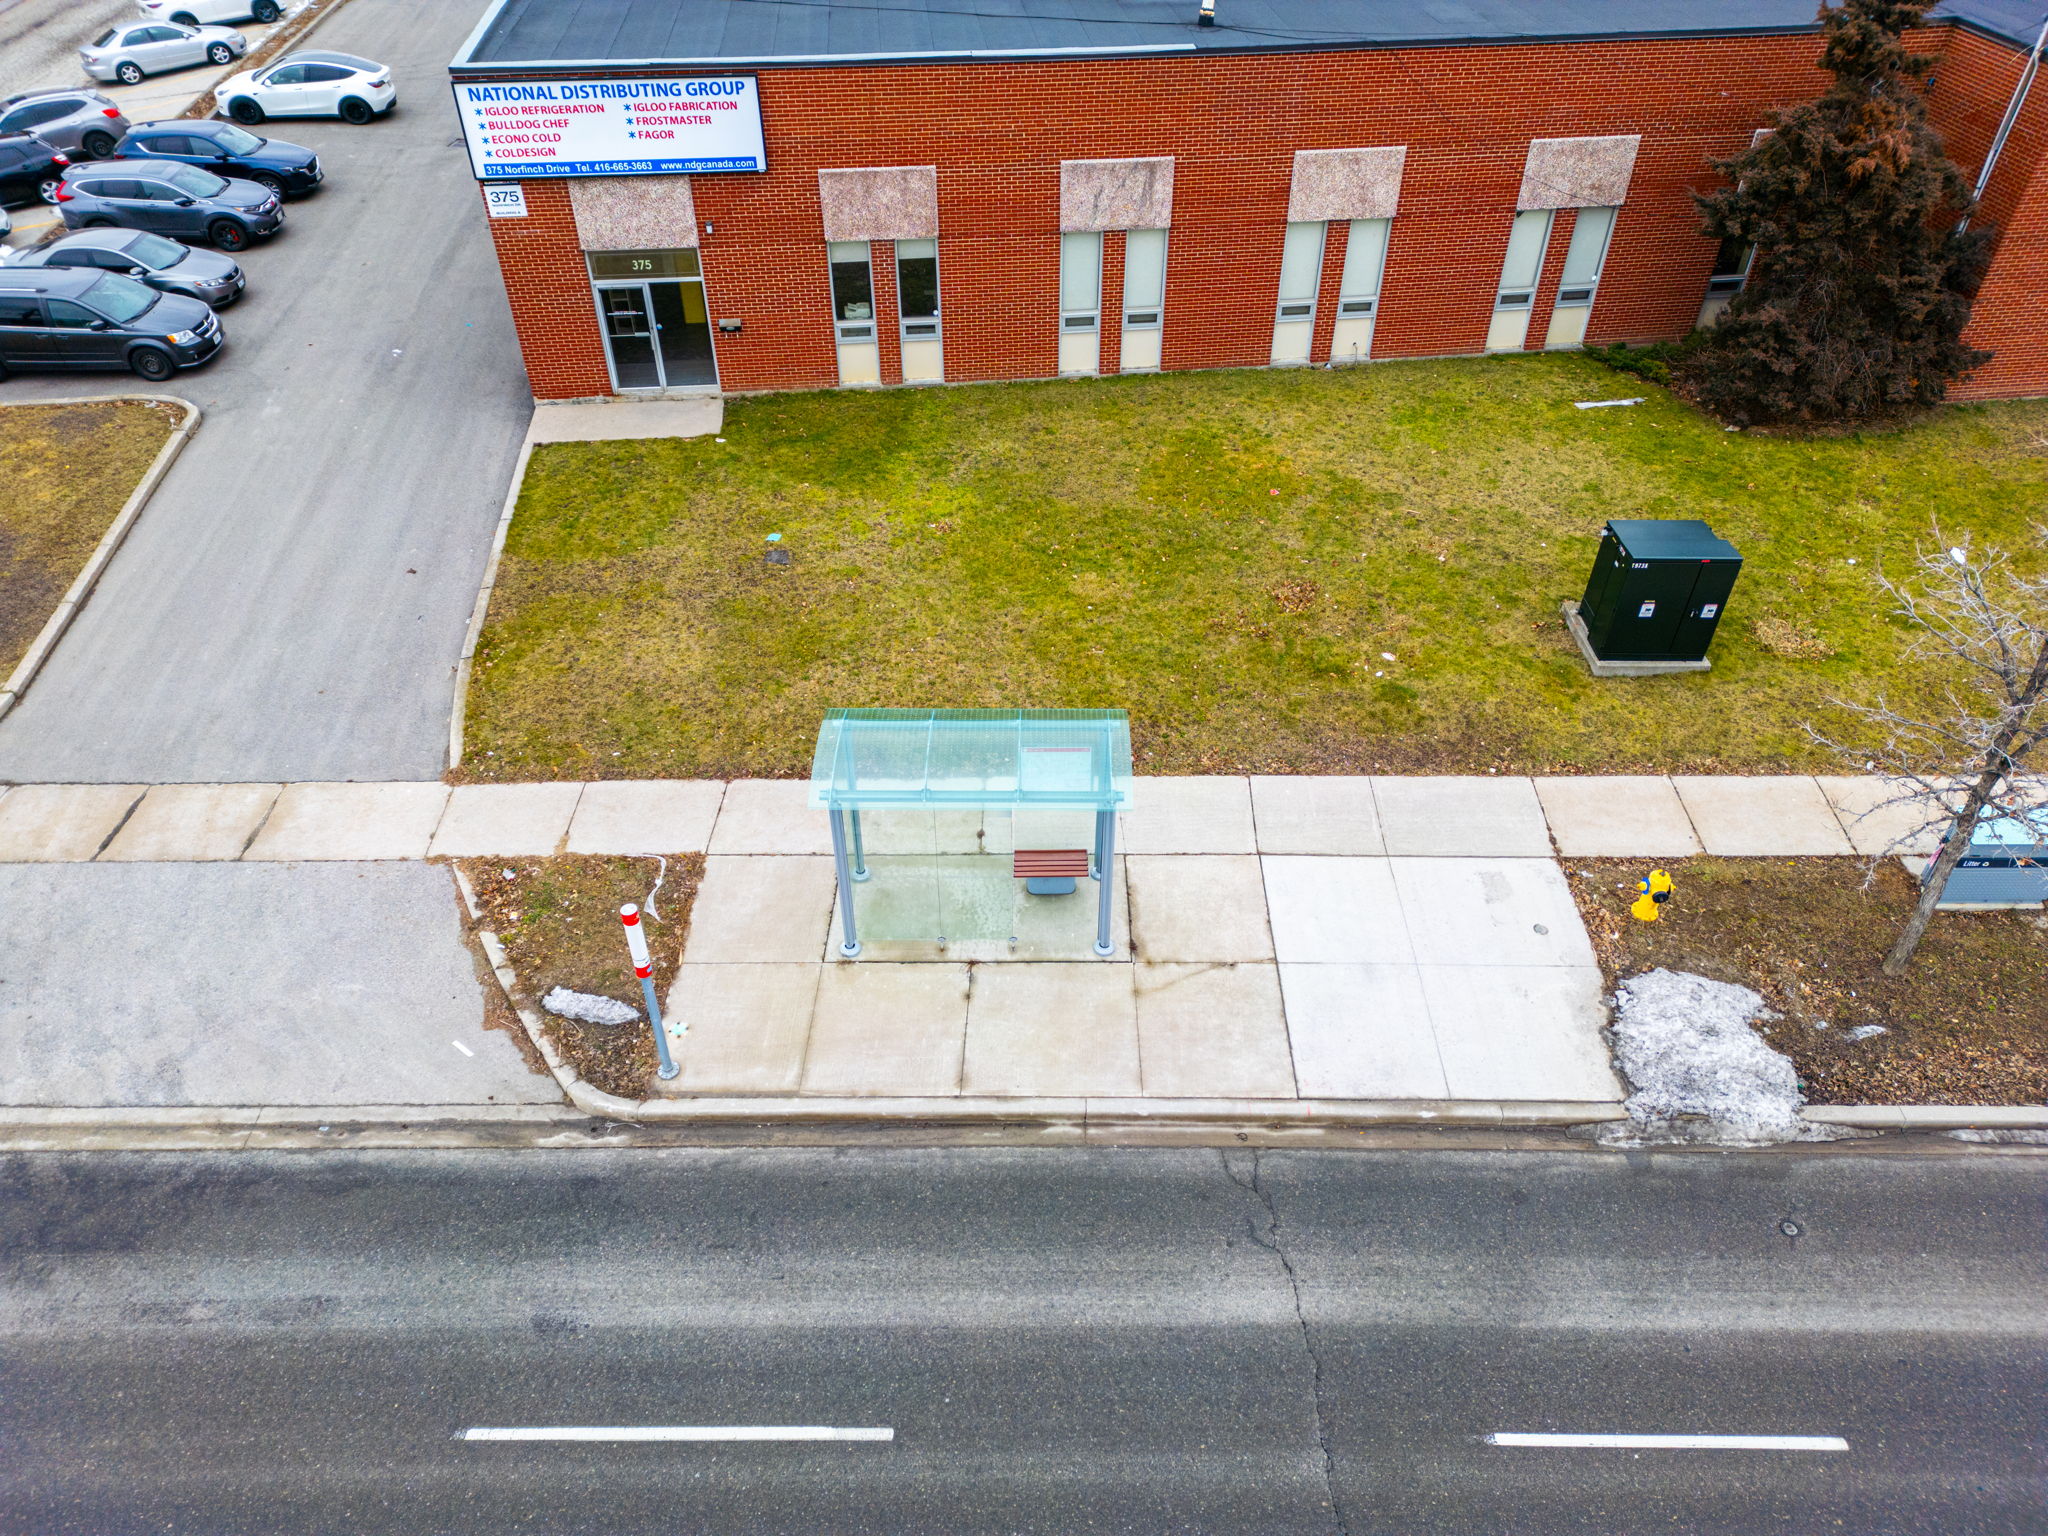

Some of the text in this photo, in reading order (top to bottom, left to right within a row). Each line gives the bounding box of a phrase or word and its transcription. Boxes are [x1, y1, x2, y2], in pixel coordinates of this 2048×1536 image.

[467, 81, 745, 102] NATIONAL DISTRIBUTING GROUP
[484, 104, 605, 116] IGLOO REFRIGERATION
[633, 101, 738, 112] IGLOO FABRICATION
[488, 119, 570, 131] BULLDOG CHEF
[635, 115, 712, 126] FROSTMASTER
[491, 133, 561, 145] ECONO COLD
[637, 130, 675, 140] FAGOR
[495, 147, 557, 158] COLDESIGN
[486, 159, 755, 175] 375 Norfinch Drive Tel. 416-665-3663 www.ndgcanada.com
[490, 191, 520, 203] 375
[632, 259, 653, 270] 375
